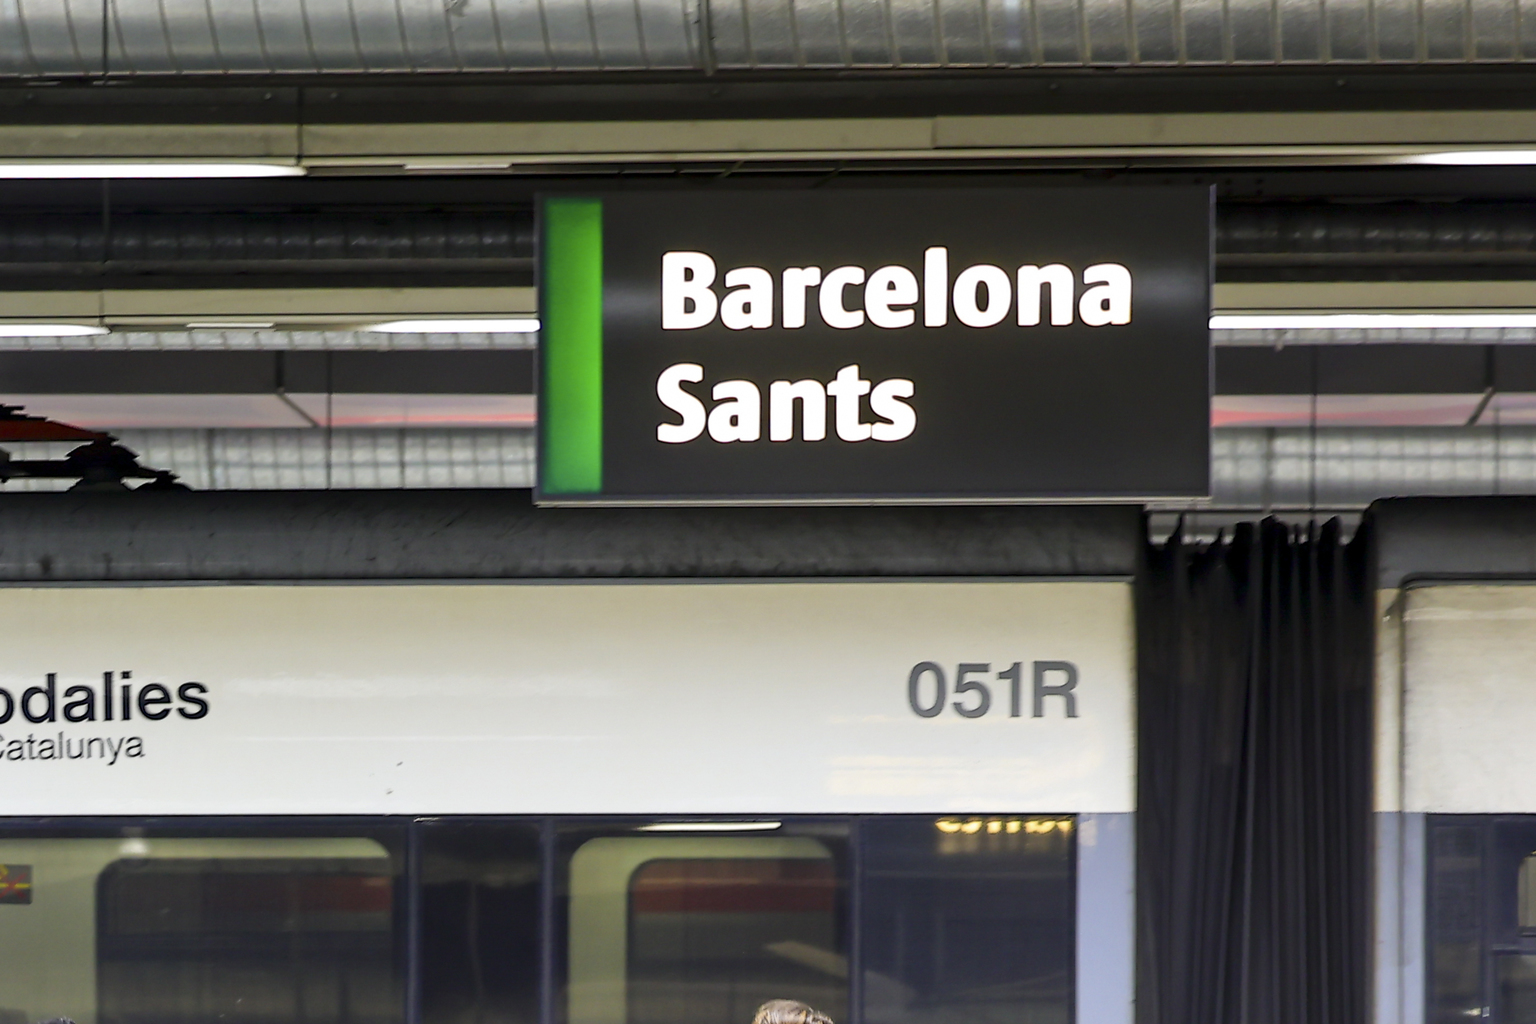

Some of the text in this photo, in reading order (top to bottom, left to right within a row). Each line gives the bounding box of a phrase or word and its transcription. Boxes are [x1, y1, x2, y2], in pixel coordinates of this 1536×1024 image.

[661, 247, 1133, 330] Barcelona
[656, 362, 917, 443] Sants
[908, 660, 1080, 719] 051R
